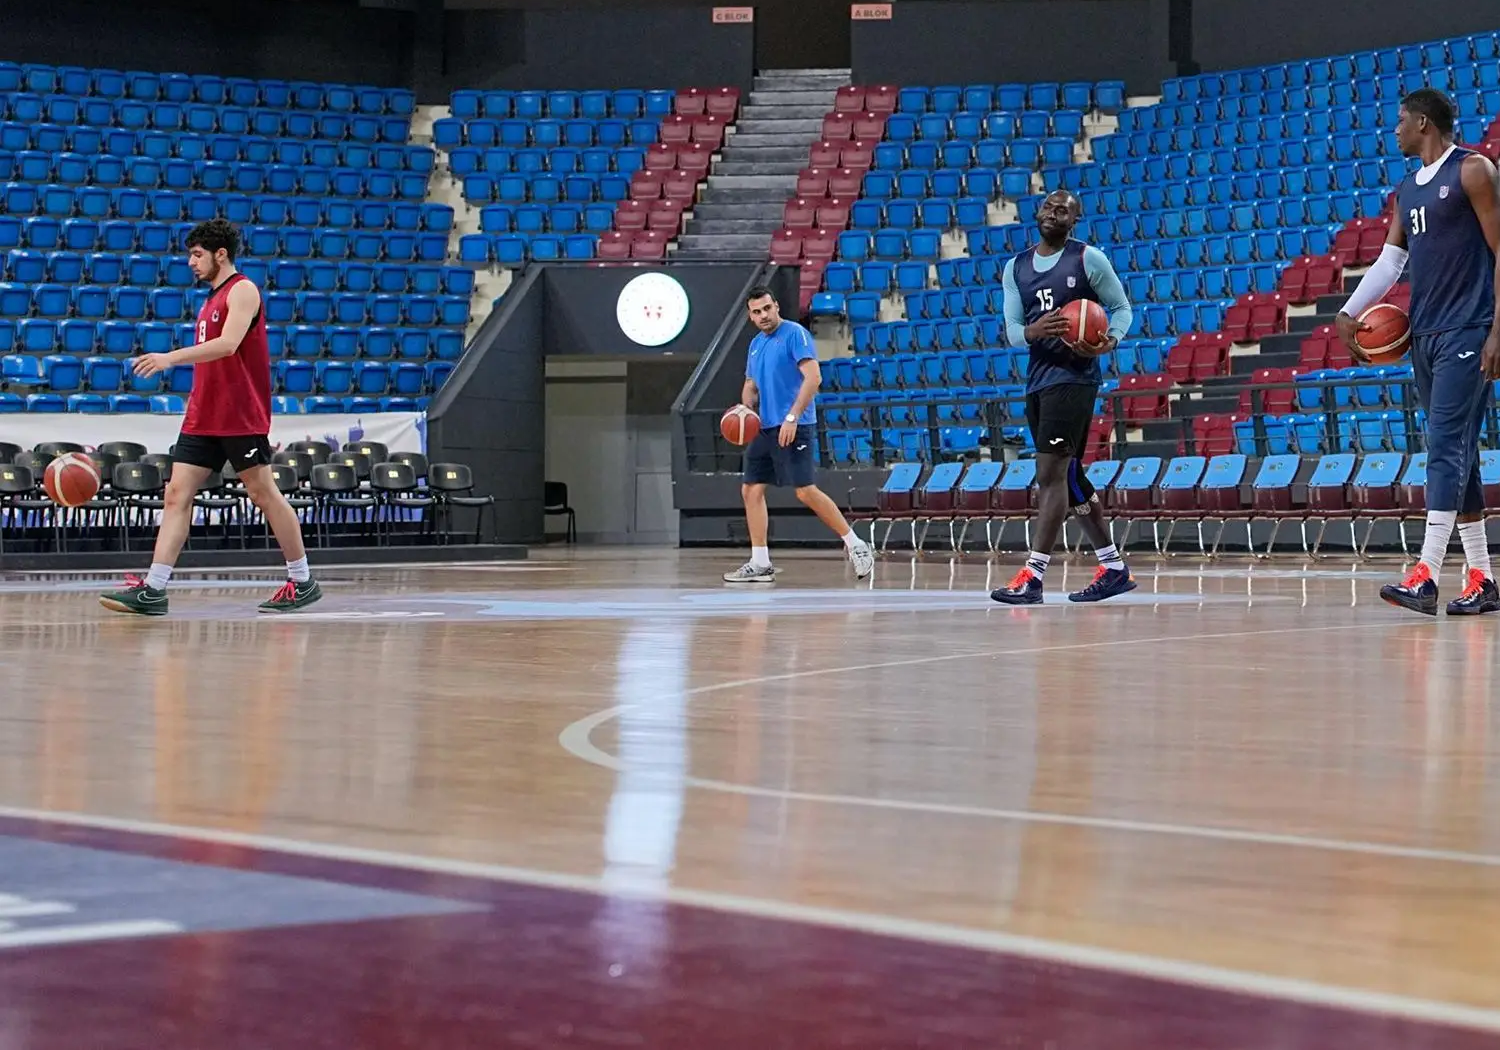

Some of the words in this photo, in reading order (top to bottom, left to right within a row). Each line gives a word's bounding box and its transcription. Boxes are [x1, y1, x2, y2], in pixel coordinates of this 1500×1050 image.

[855, 9, 861, 17] A
[864, 9, 888, 17] BLOK
[1410, 206, 1426, 235] 31
[1035, 289, 1053, 311] 15
